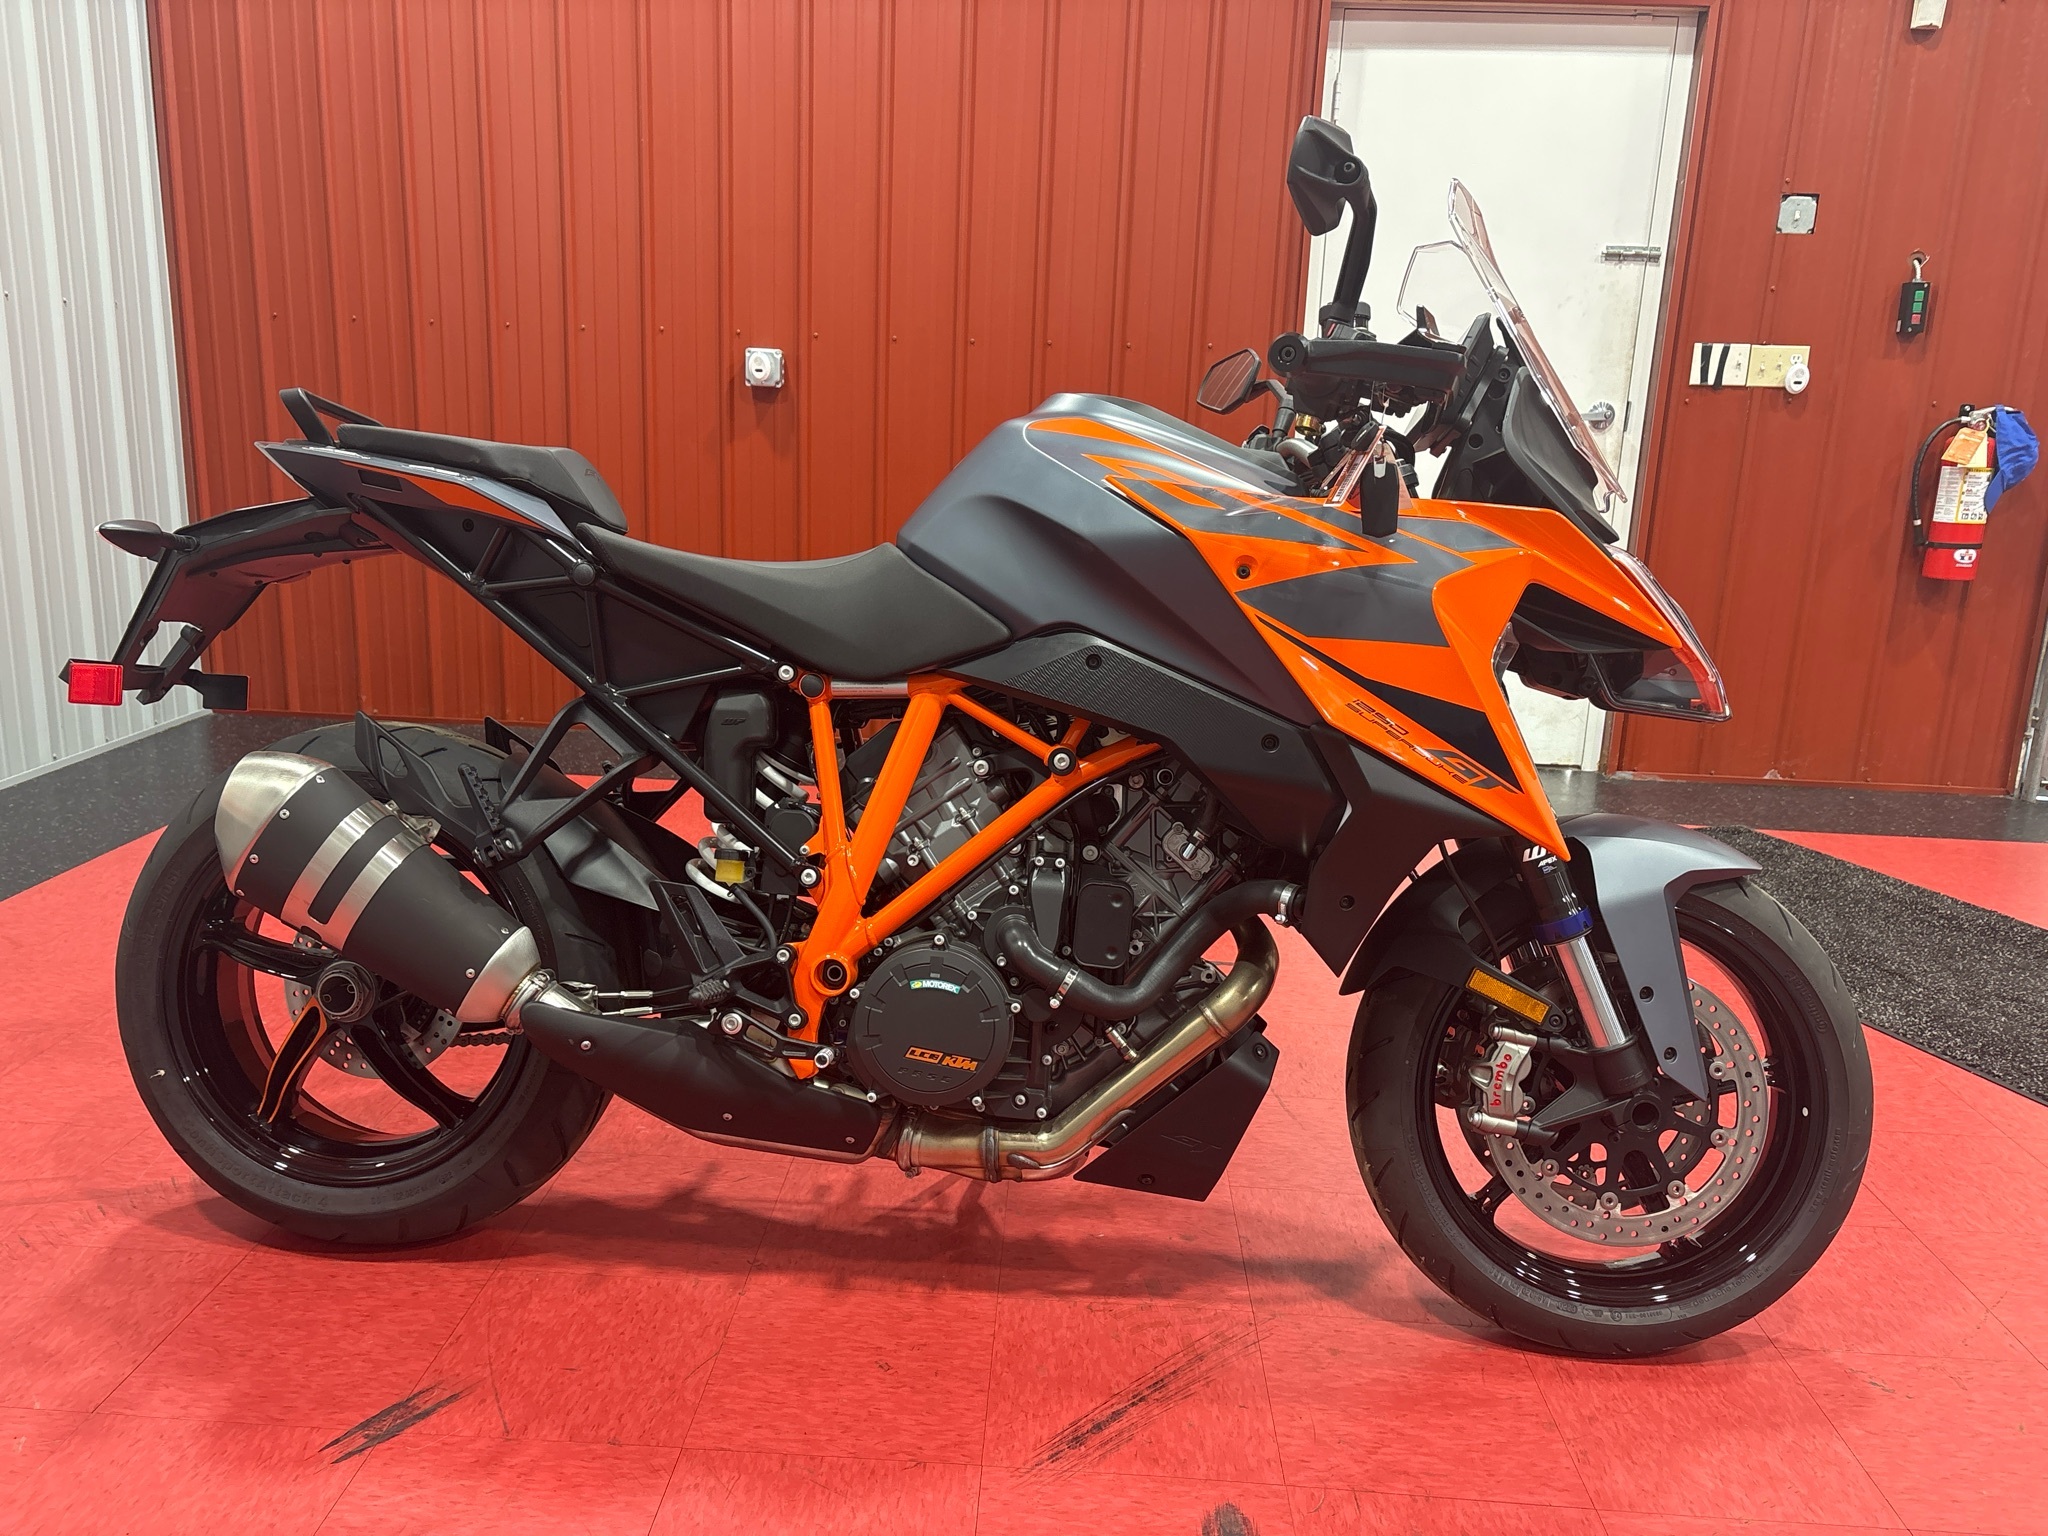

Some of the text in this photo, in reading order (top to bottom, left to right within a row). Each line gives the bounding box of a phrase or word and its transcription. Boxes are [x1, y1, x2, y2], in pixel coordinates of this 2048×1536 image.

[1352, 699, 1409, 737] 1290
[1424, 748, 1519, 794] GT
[1522, 845, 1552, 863] W
[922, 980, 957, 993] MOTOREX
[941, 1055, 978, 1071] KTM
[1490, 1053, 1513, 1108] brembo
